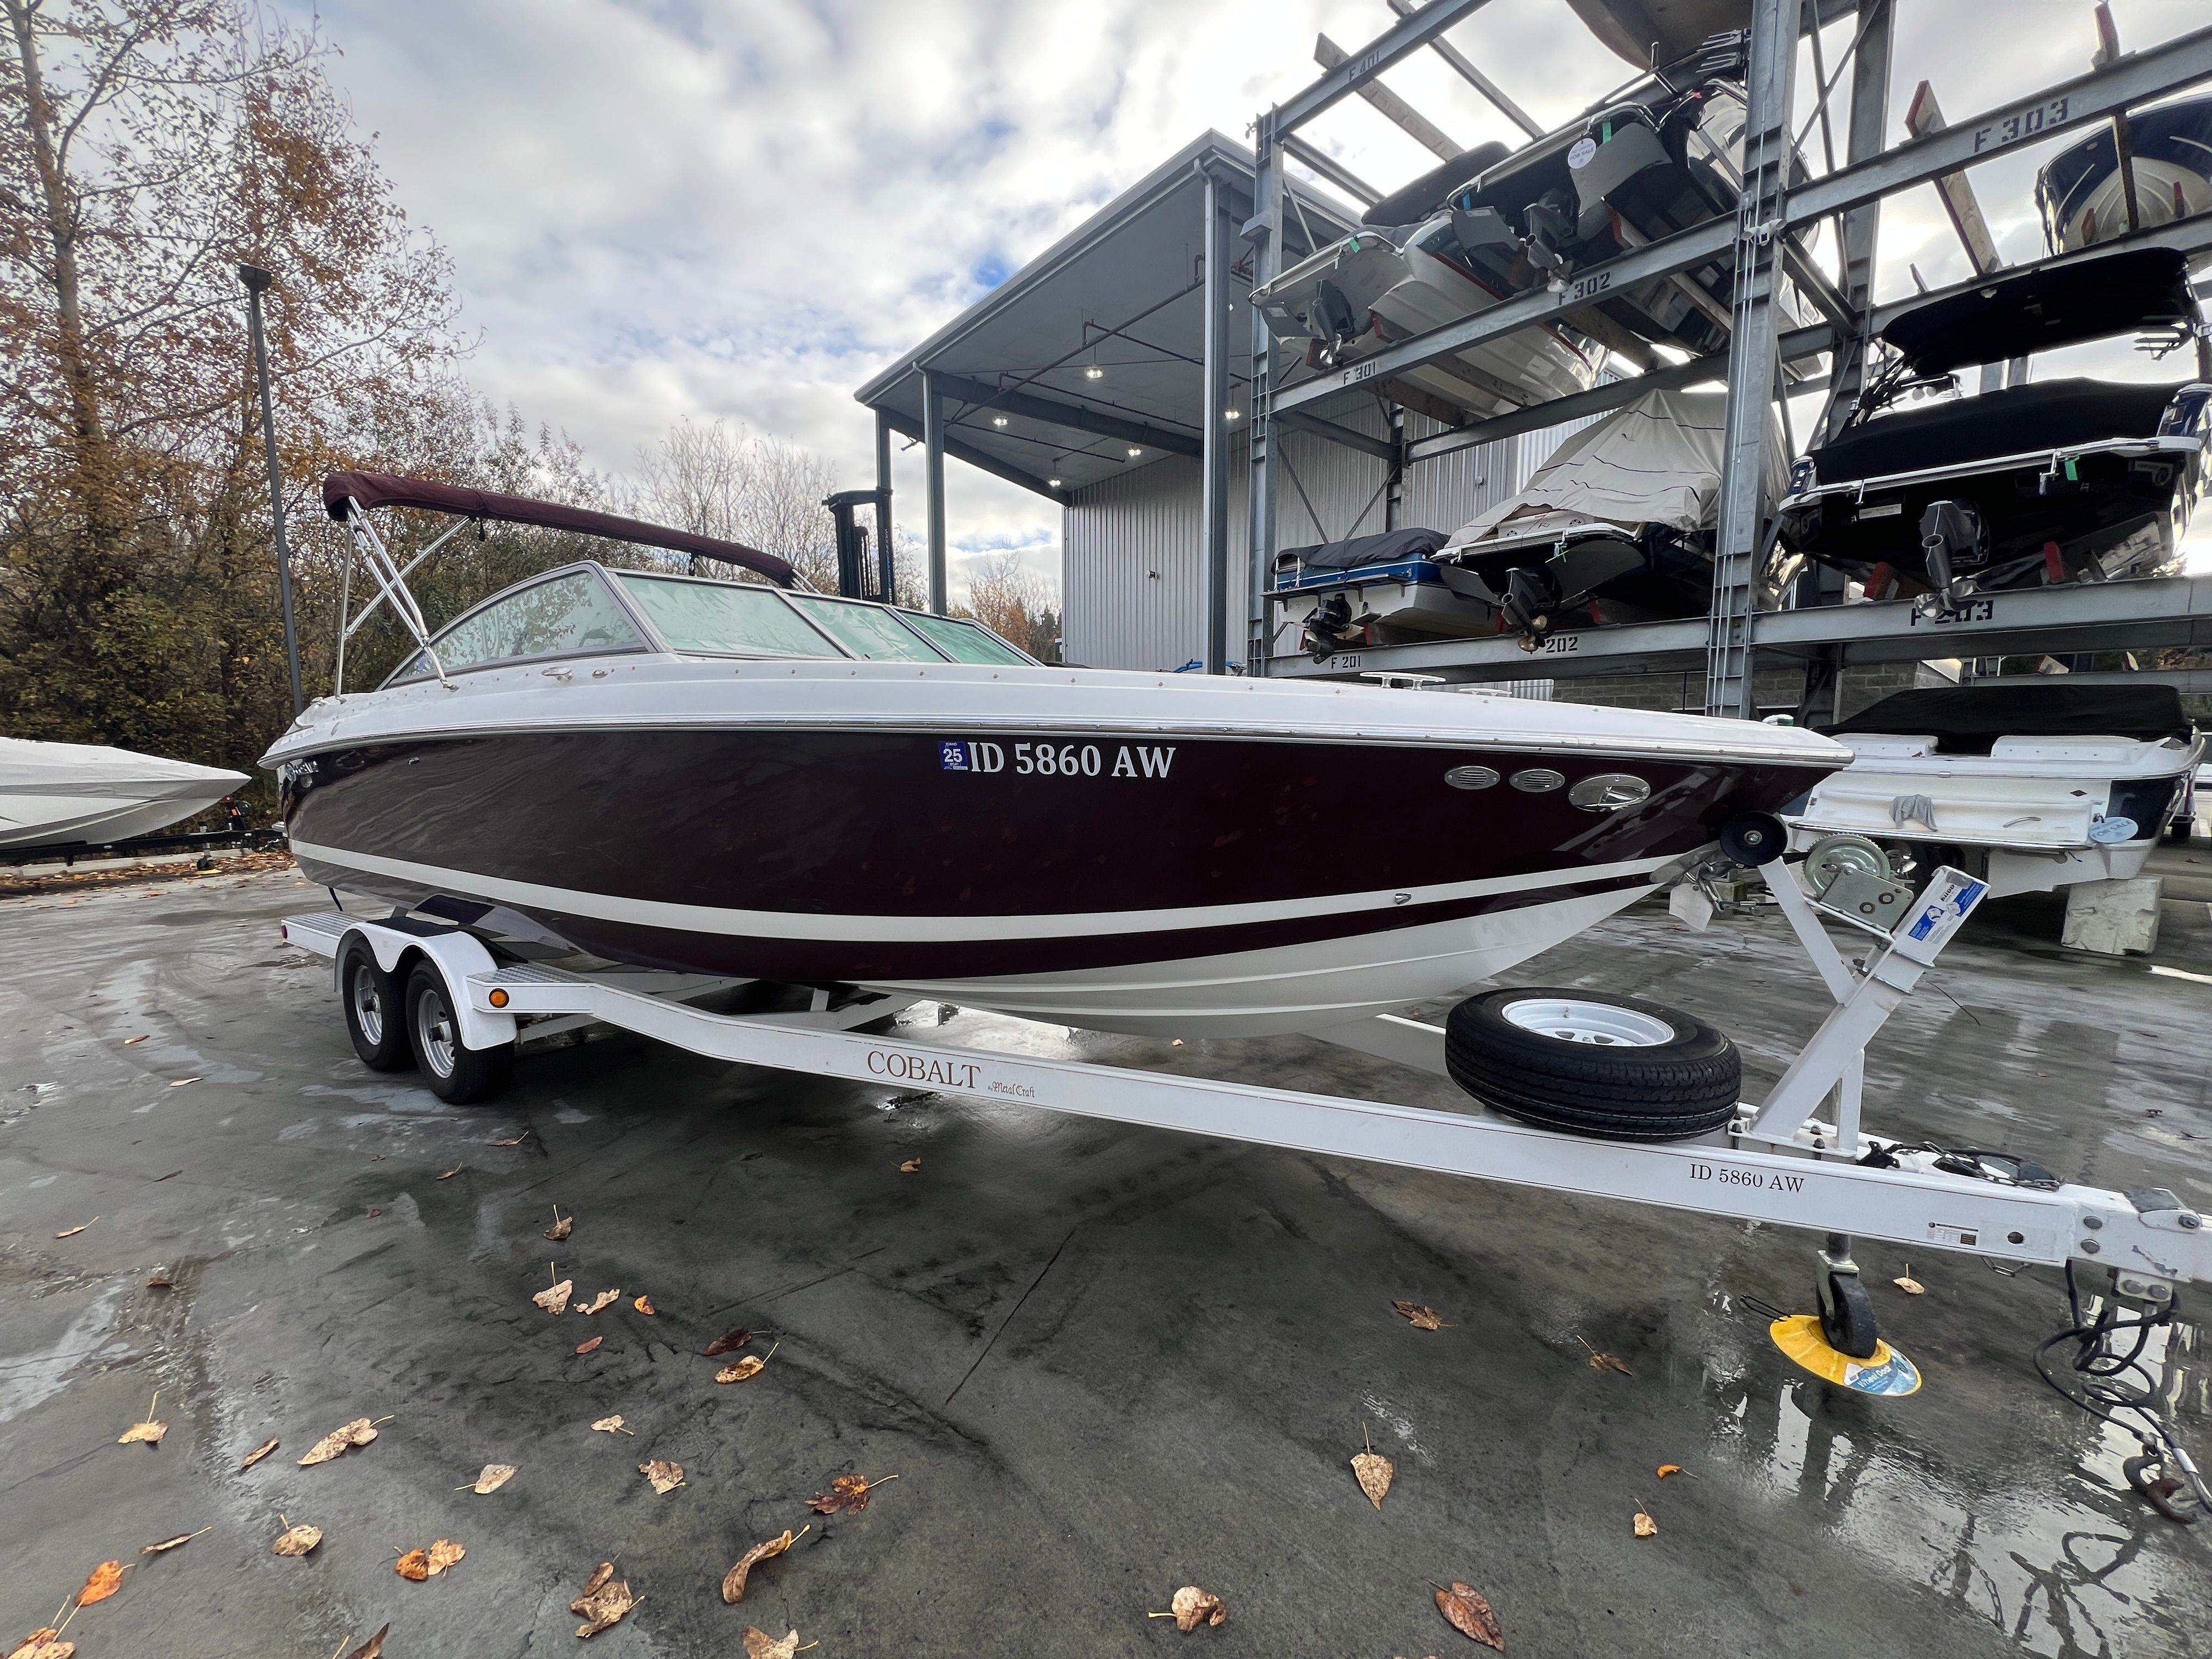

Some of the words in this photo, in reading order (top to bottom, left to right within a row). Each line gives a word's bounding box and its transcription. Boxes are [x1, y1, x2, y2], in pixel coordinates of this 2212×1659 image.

[1349, 66, 1356, 81] F
[1360, 49, 1379, 74] 401
[1974, 127, 1992, 153] F
[2001, 97, 2068, 143] 303
[1574, 271, 1611, 300] 302
[1344, 371, 1350, 385] F
[1356, 361, 1376, 381] 301
[1546, 636, 1578, 653] 202
[1331, 657, 1338, 669] F
[1342, 655, 1361, 668] 201
[943, 748, 963, 763] 25
[968, 742, 1005, 772] ID
[1015, 743, 1101, 776] 5860
[1111, 746, 1176, 778] AW
[867, 1051, 981, 1089] COBALT
[992, 1081, 1015, 1095] Metal
[1016, 1085, 1035, 1098] Craft
[1690, 1163, 1712, 1180] ID
[1719, 1168, 1763, 1188] 5860
[1768, 1175, 1805, 1193] AW
[1857, 1372, 1880, 1388] Wheel
